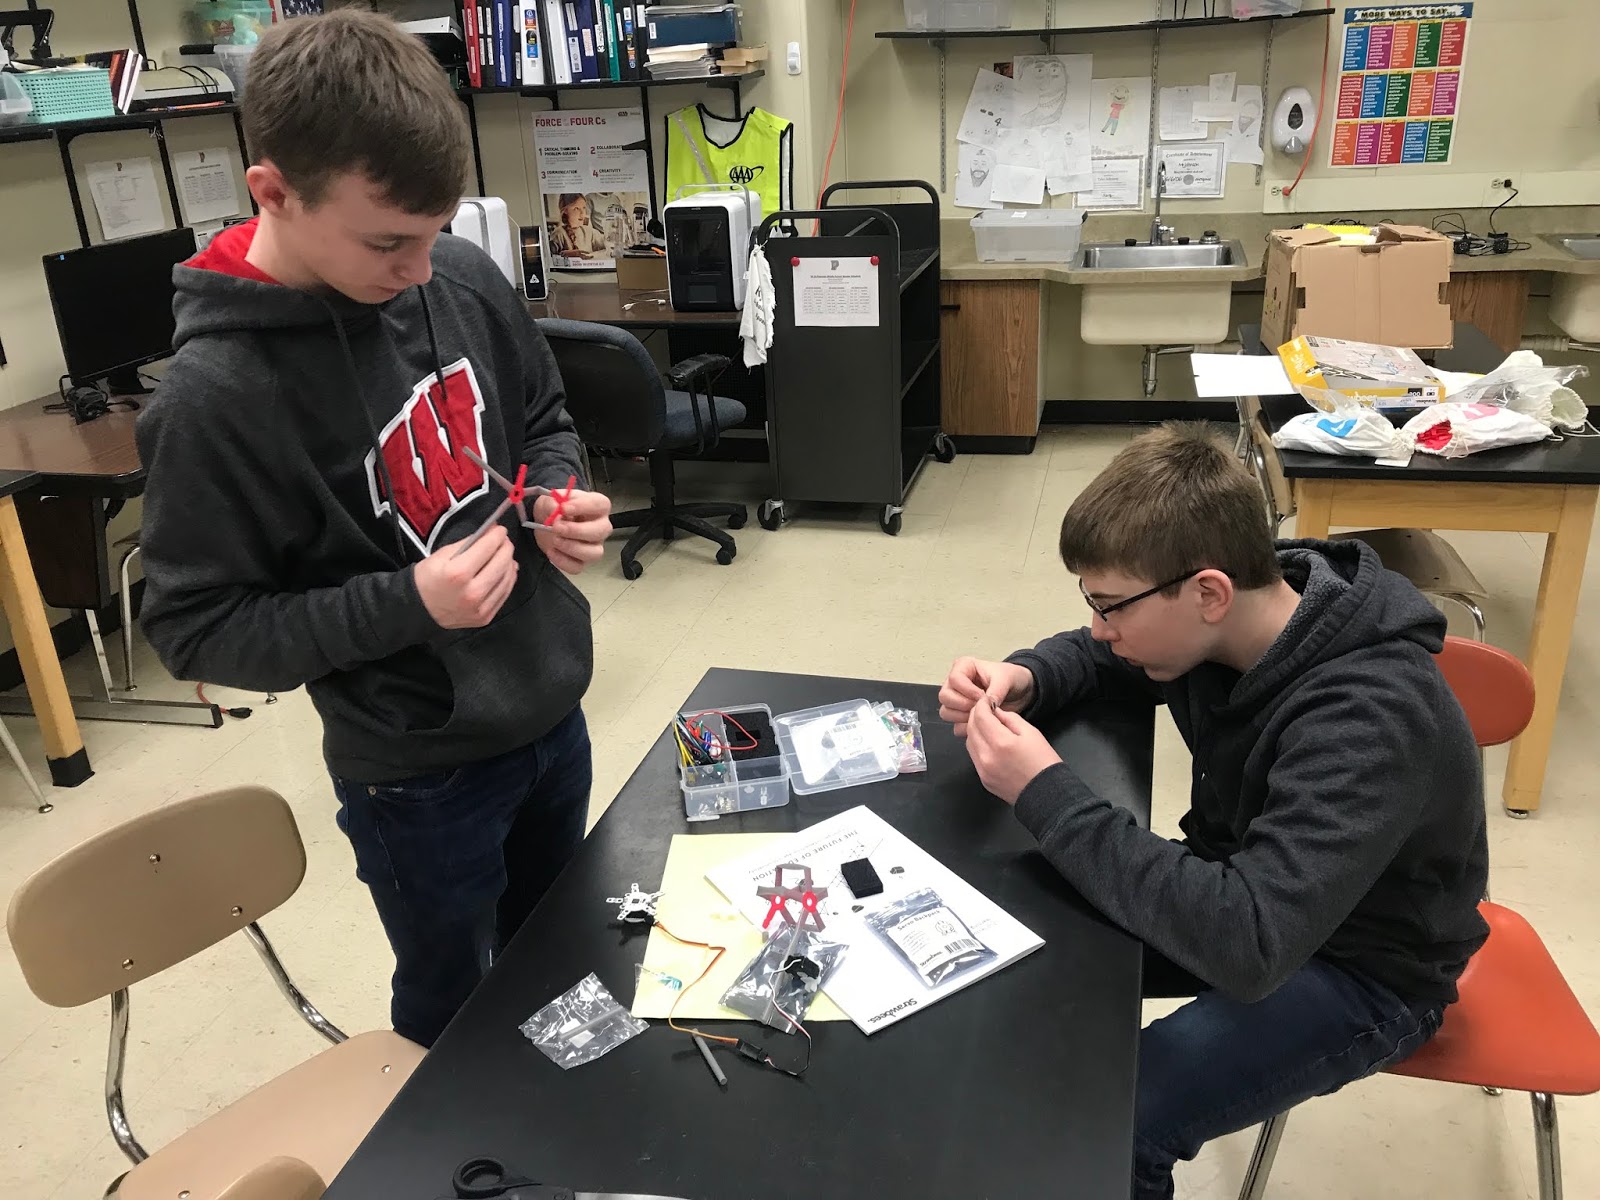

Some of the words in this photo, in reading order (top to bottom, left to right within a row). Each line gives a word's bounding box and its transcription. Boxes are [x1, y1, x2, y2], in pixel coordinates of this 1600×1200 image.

[535, 118, 562, 127] FORCE
[570, 117, 594, 126] FOUR
[590, 146, 596, 155] 2
[541, 171, 546, 179] 3
[730, 166, 752, 184] AAA
[844, 830, 858, 839] THE
[814, 837, 842, 853] FUTURE
[802, 852, 812, 860] OF
[914, 910, 940, 921] Backpack
